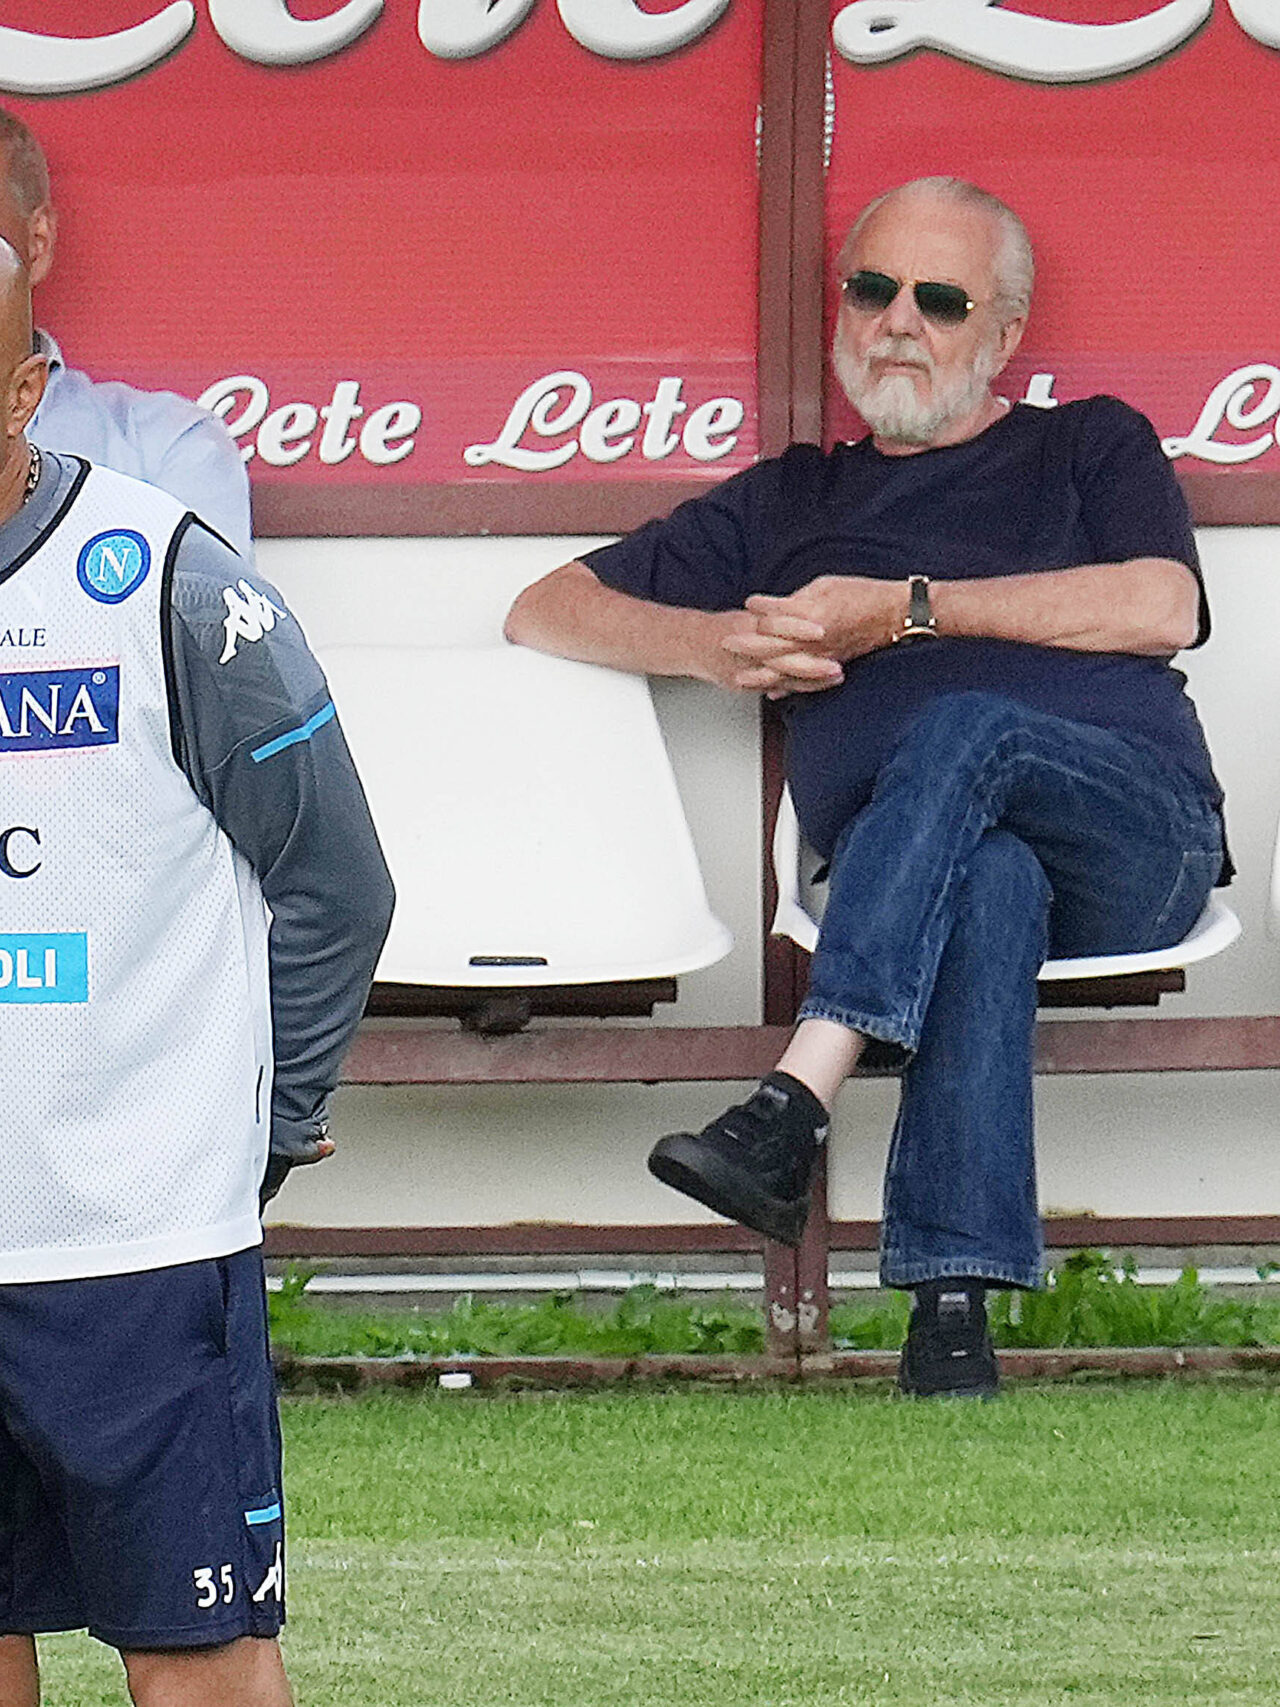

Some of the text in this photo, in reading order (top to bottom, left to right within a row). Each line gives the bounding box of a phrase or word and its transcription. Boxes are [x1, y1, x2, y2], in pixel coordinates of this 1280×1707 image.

[463, 370, 745, 472] Lete
[95, 546, 134, 583] N
[194, 1563, 234, 1608] 35
